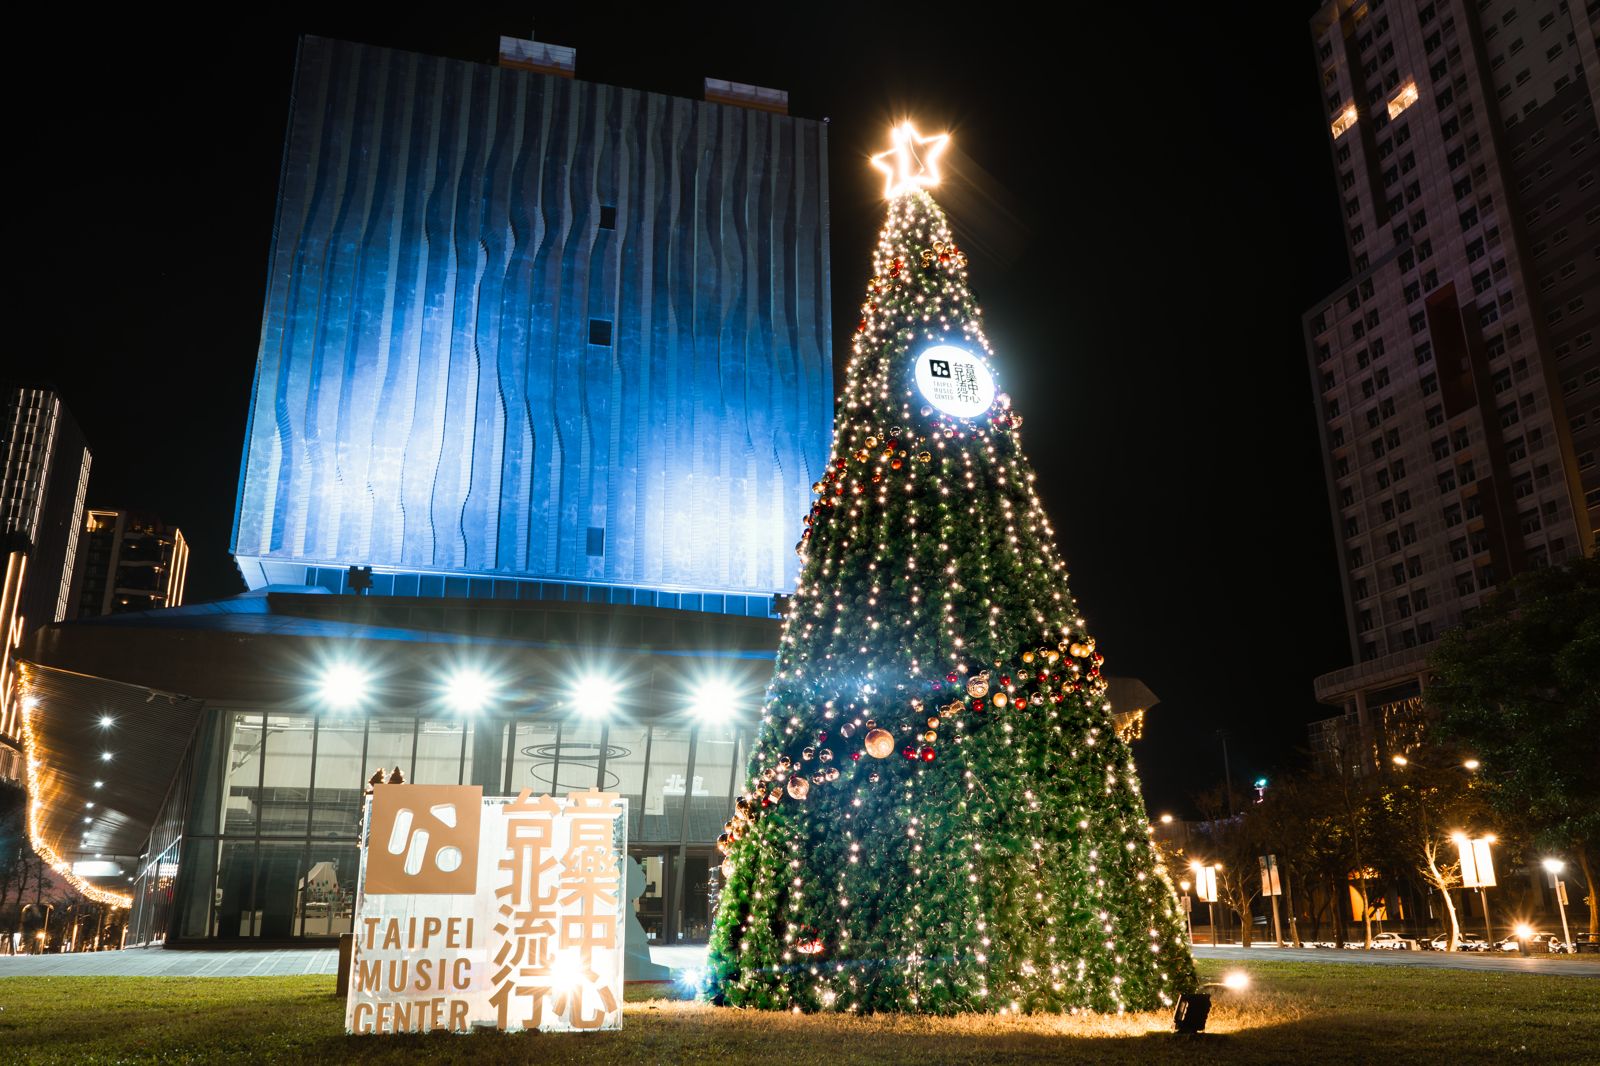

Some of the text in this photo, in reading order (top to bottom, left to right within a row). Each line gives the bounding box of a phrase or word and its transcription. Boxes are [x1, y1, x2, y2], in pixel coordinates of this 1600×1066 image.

[489, 787, 561, 1030] 台北流行
[551, 787, 622, 1029] 音樂中心
[364, 917, 475, 950] TAIPEI
[357, 957, 472, 993] MUSIC
[353, 997, 470, 1035] CENTER
